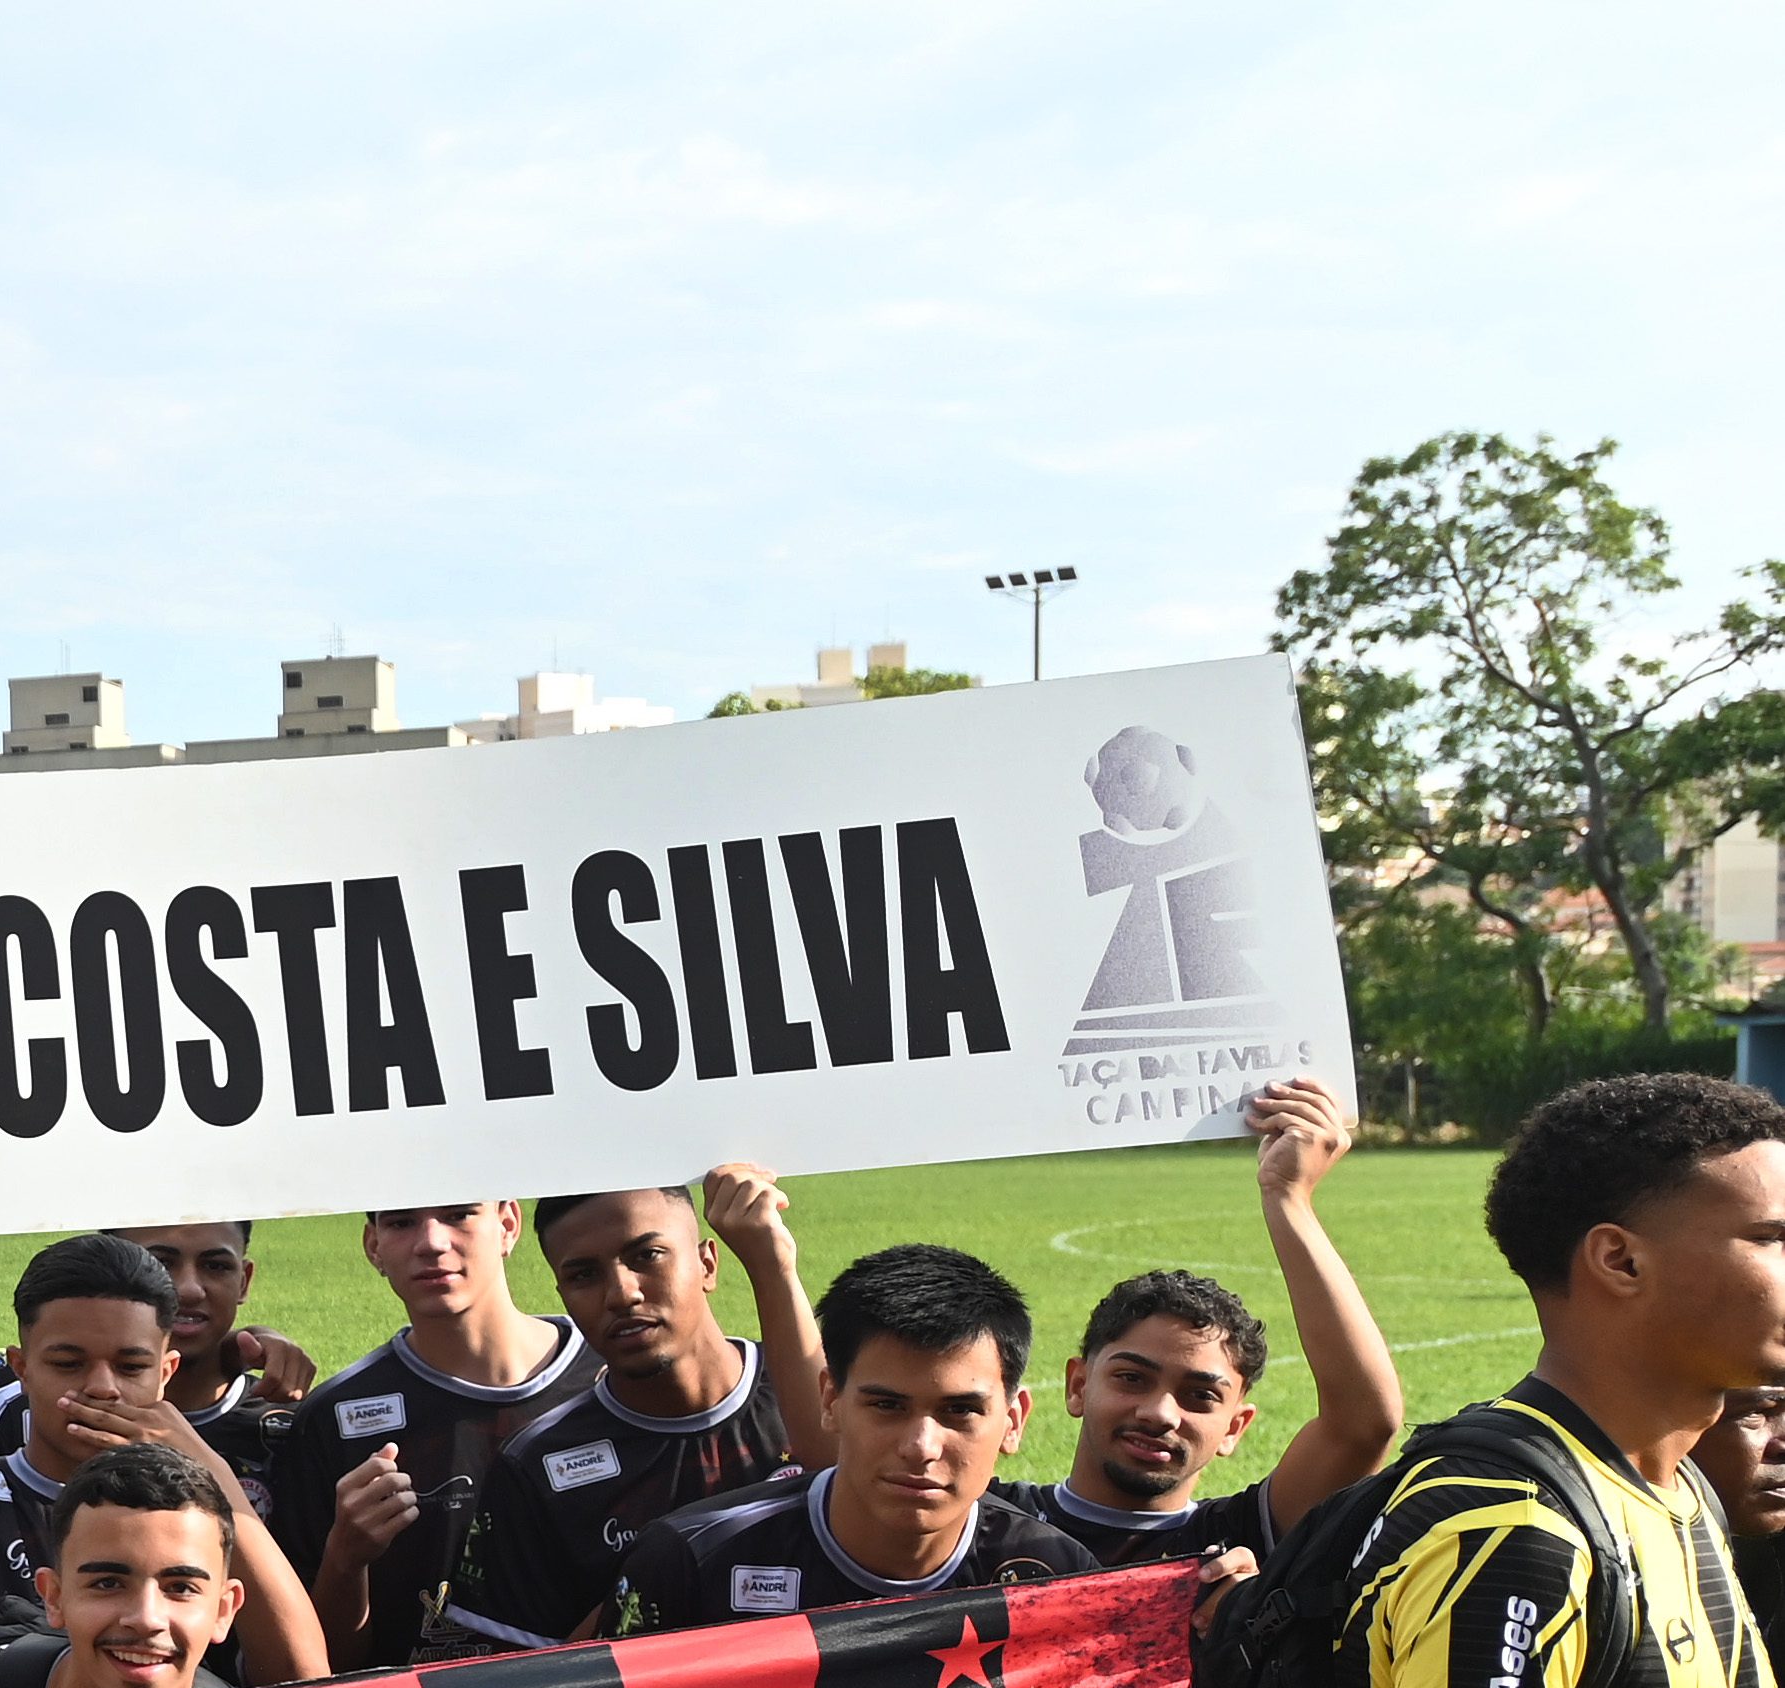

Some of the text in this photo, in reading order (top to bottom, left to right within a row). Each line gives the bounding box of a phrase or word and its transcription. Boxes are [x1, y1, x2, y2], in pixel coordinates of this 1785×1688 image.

[459, 864, 555, 1101] E
[571, 816, 1012, 1092] SILVA
[1086, 1081, 1258, 1127] CAMPINA
[354, 1404, 394, 1420] ANDRÉ
[566, 1451, 606, 1471] ANDRÉ
[750, 1578, 789, 1594] ANDRÉ
